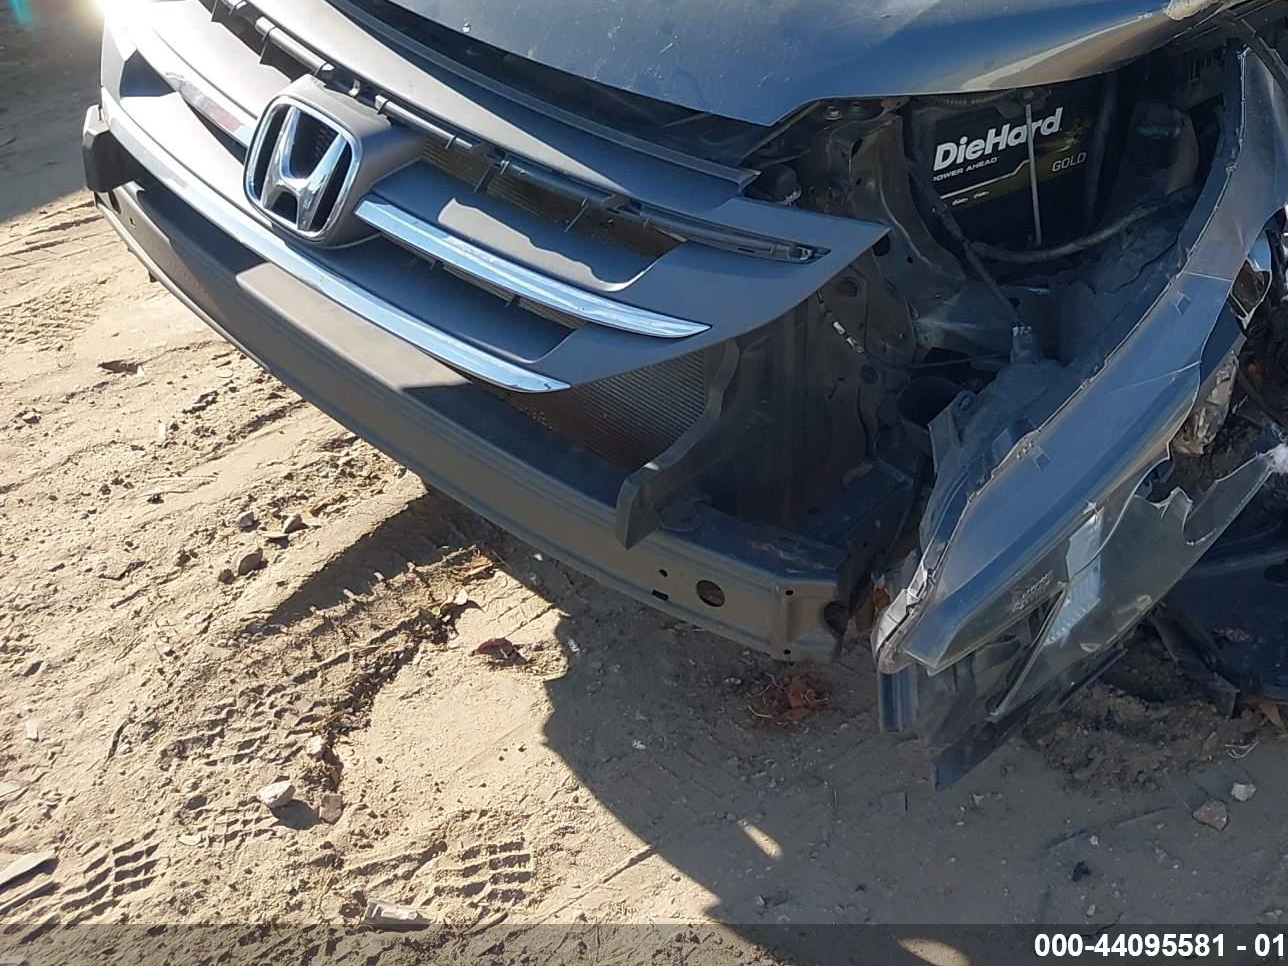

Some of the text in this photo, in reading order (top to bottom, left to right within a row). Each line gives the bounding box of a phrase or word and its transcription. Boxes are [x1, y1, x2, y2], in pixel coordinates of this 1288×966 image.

[933, 107, 1063, 171] DieHard
[965, 157, 998, 172] AHEAD
[1052, 152, 1087, 172] GOLD
